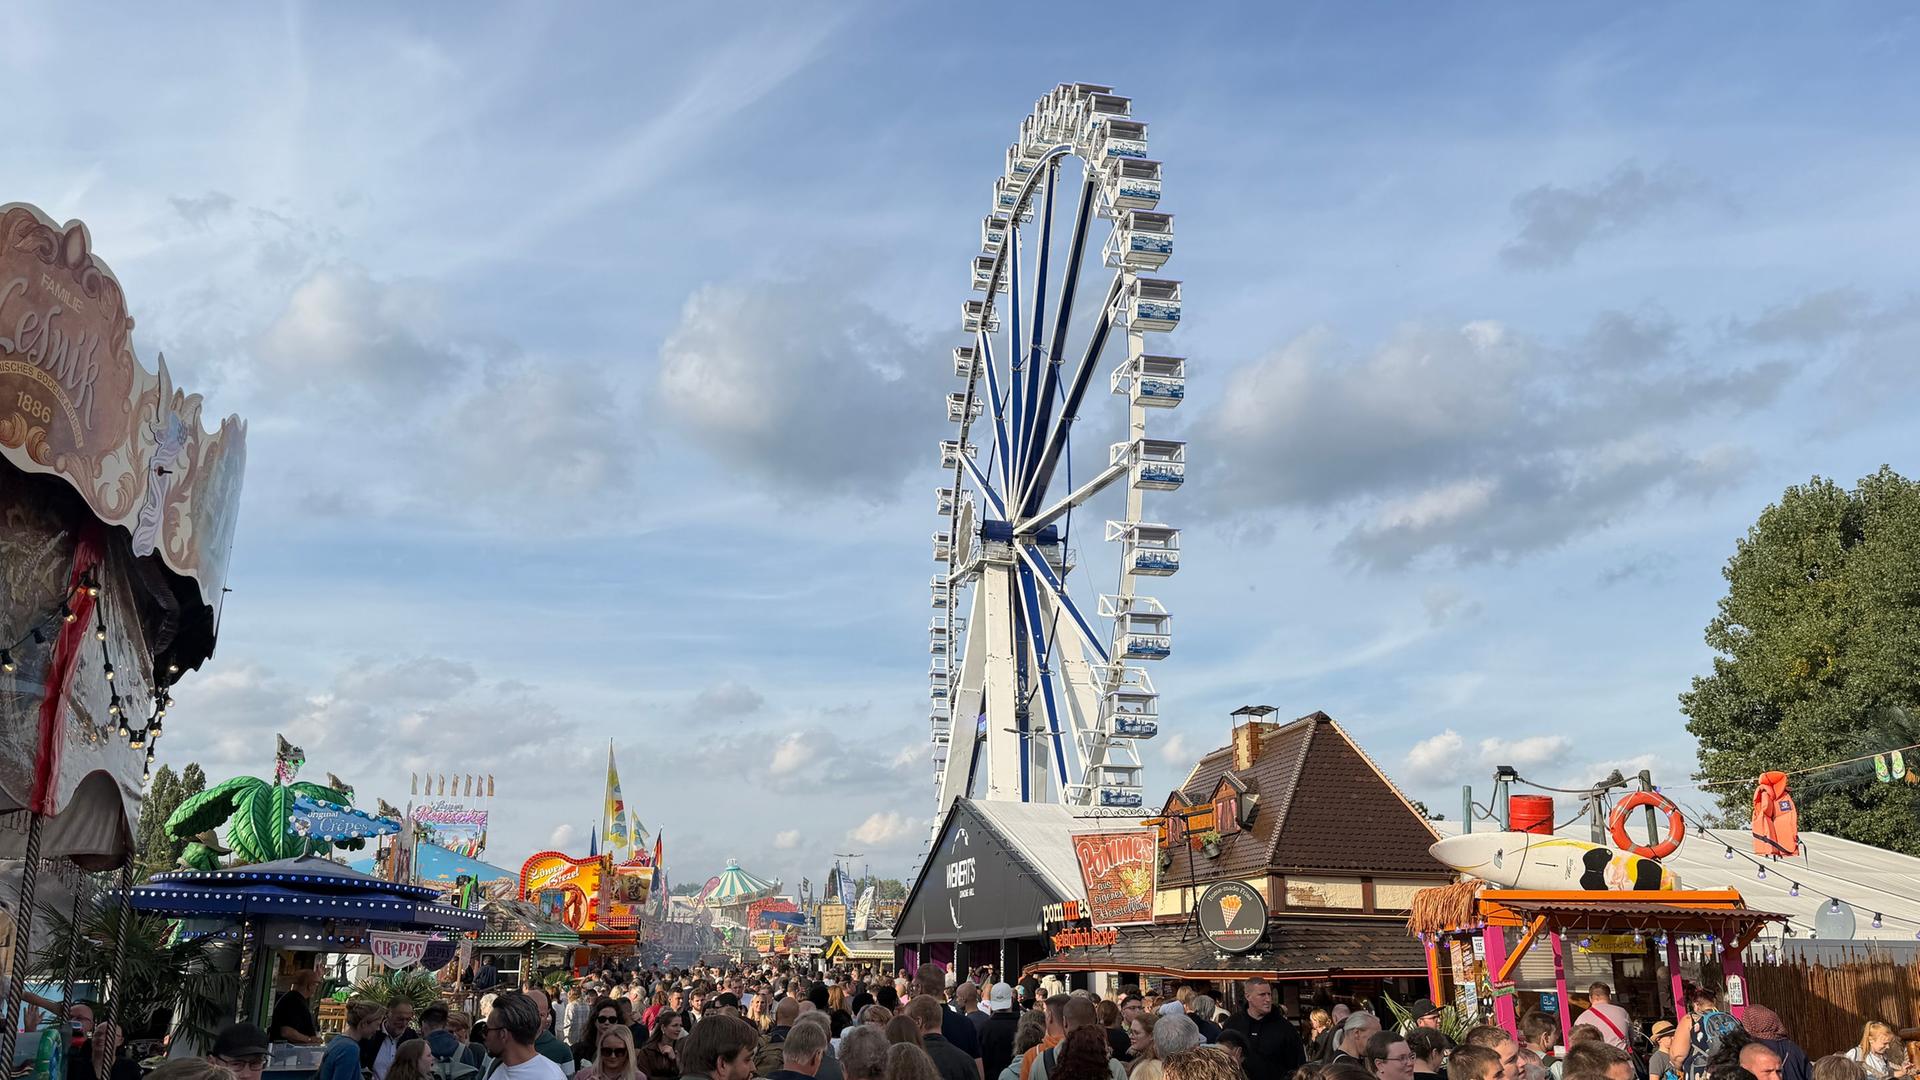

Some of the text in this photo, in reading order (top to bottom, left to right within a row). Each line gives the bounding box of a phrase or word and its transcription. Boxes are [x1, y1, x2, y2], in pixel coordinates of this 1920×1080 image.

[40, 272, 84, 314] FAMILIE
[17, 391, 52, 424] 1886
[1076, 836, 1154, 889] Pommes
[1097, 881, 1113, 890] aus
[1207, 885, 1240, 902] Home-made
[1042, 899, 1090, 931] pommes
[1209, 929, 1242, 937] pommes
